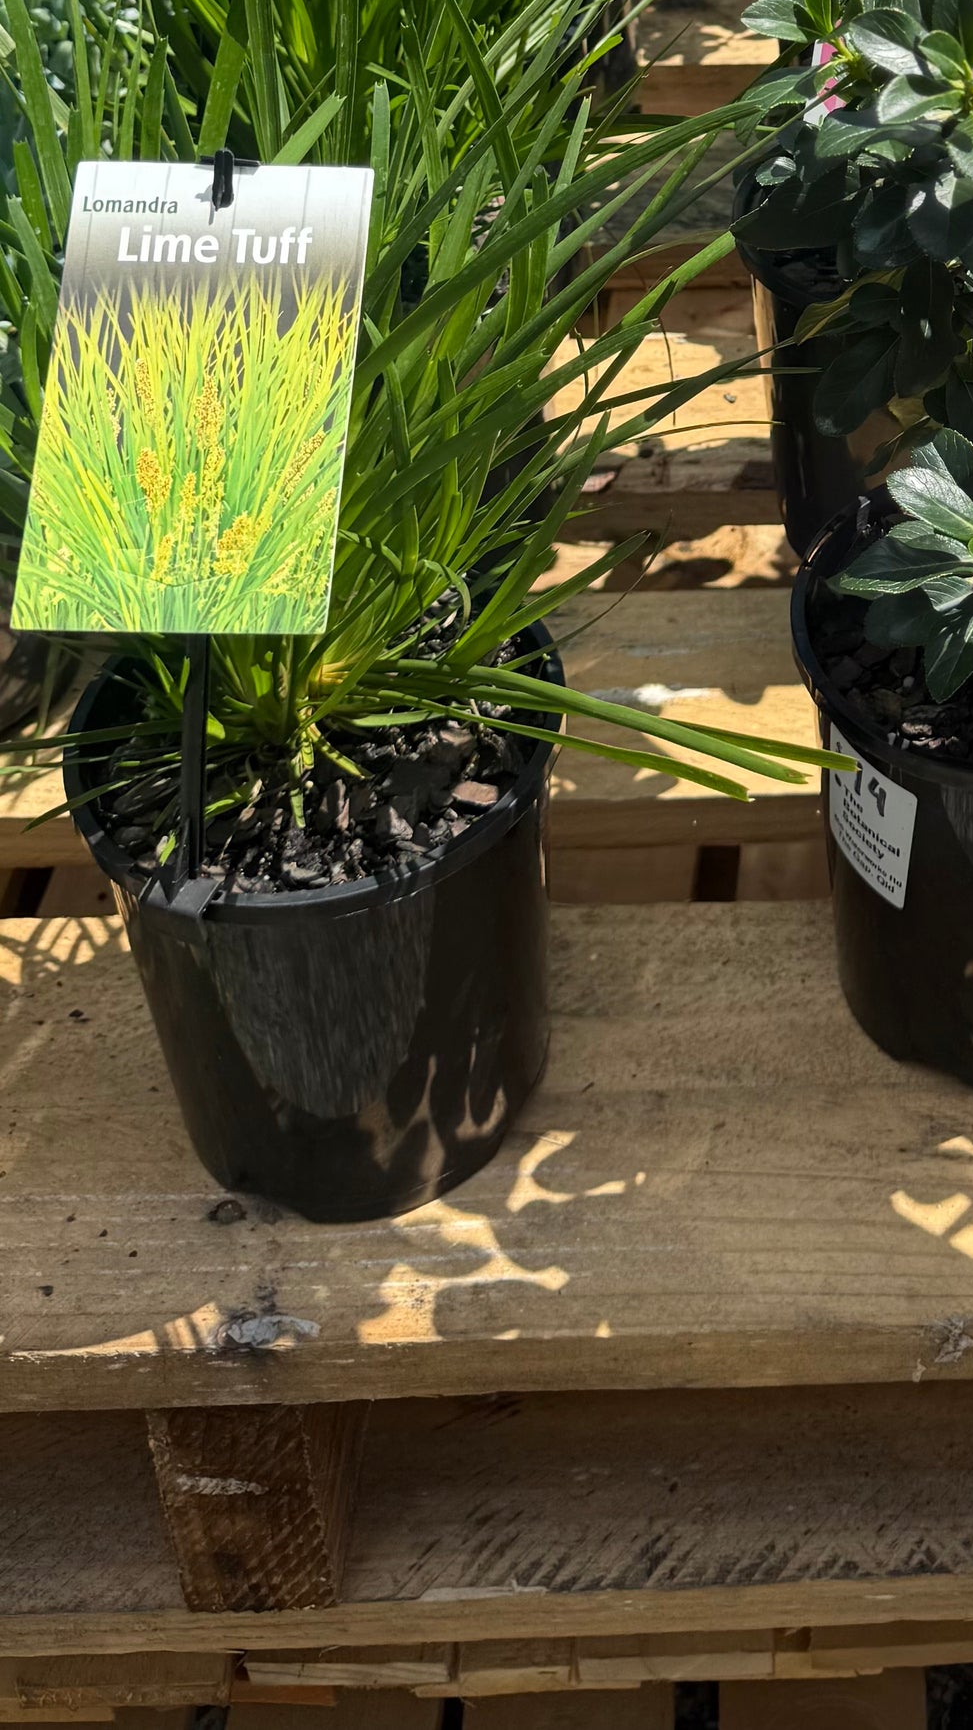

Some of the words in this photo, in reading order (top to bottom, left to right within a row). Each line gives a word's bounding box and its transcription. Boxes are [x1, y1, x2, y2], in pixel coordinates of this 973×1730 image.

[83, 196, 178, 214] Lomandra
[117, 225, 219, 263] Lime
[232, 226, 313, 264] Tuff
[843, 797, 900, 858] Botanical
